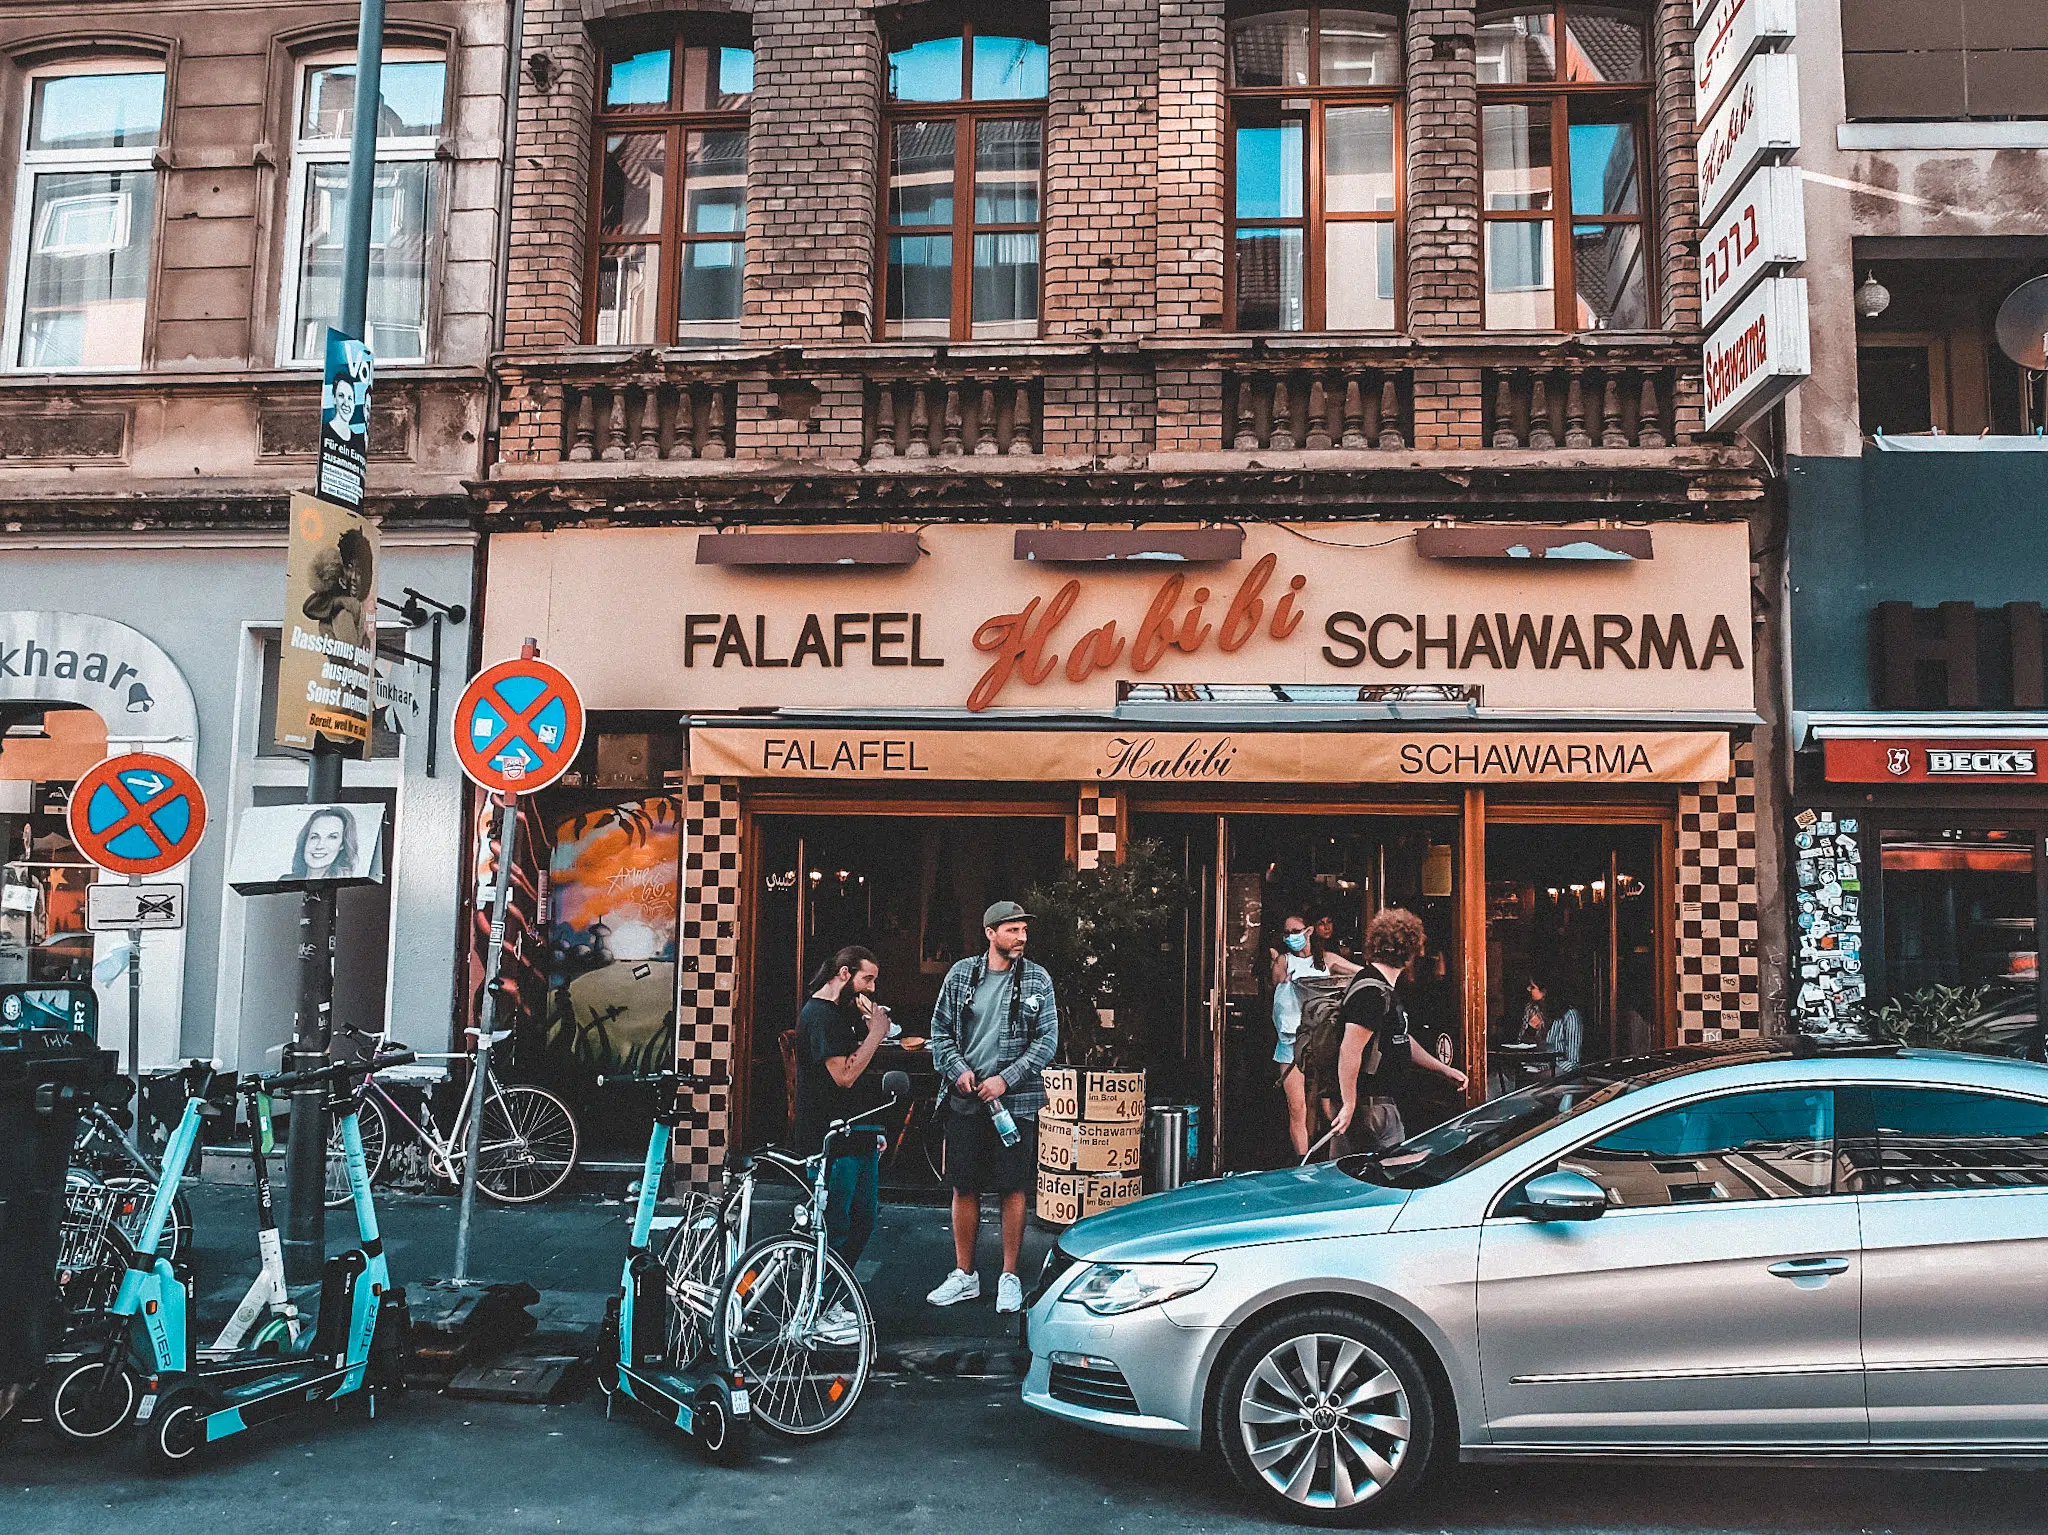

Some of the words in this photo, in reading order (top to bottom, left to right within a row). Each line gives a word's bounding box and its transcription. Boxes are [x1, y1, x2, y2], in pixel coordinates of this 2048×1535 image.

[1705, 204, 1760, 302] ברכה
[1706, 313, 1767, 413] Schawarma
[291, 625, 354, 661] Rassismus
[683, 611, 944, 668] FALAFEL
[967, 552, 1307, 713] Habibi
[1321, 611, 1745, 670] SCHAWARMA
[0, 640, 139, 690] khaar
[306, 680, 341, 707] Sonst
[763, 739, 929, 771] FALAFEL
[1096, 736, 1237, 778] Habibi
[1400, 743, 1653, 775] SCHAWARMA
[1929, 751, 2035, 772] BECK'S
[1043, 1072, 1072, 1090] sch
[1089, 1074, 1144, 1093] Hasch
[1101, 1094, 1117, 1102] Brot
[1116, 1100, 1144, 1120] 4,00
[1078, 1125, 1140, 1137] Schawarma
[1091, 1138, 1109, 1146] Brot
[1040, 1142, 1069, 1165] 2,50
[1107, 1147, 1139, 1169] 2,50
[1086, 1179, 1141, 1198] Falafel
[1044, 1199, 1076, 1220] 1,90
[360, 1304, 376, 1352] TIER
[154, 1319, 171, 1369] TIER
